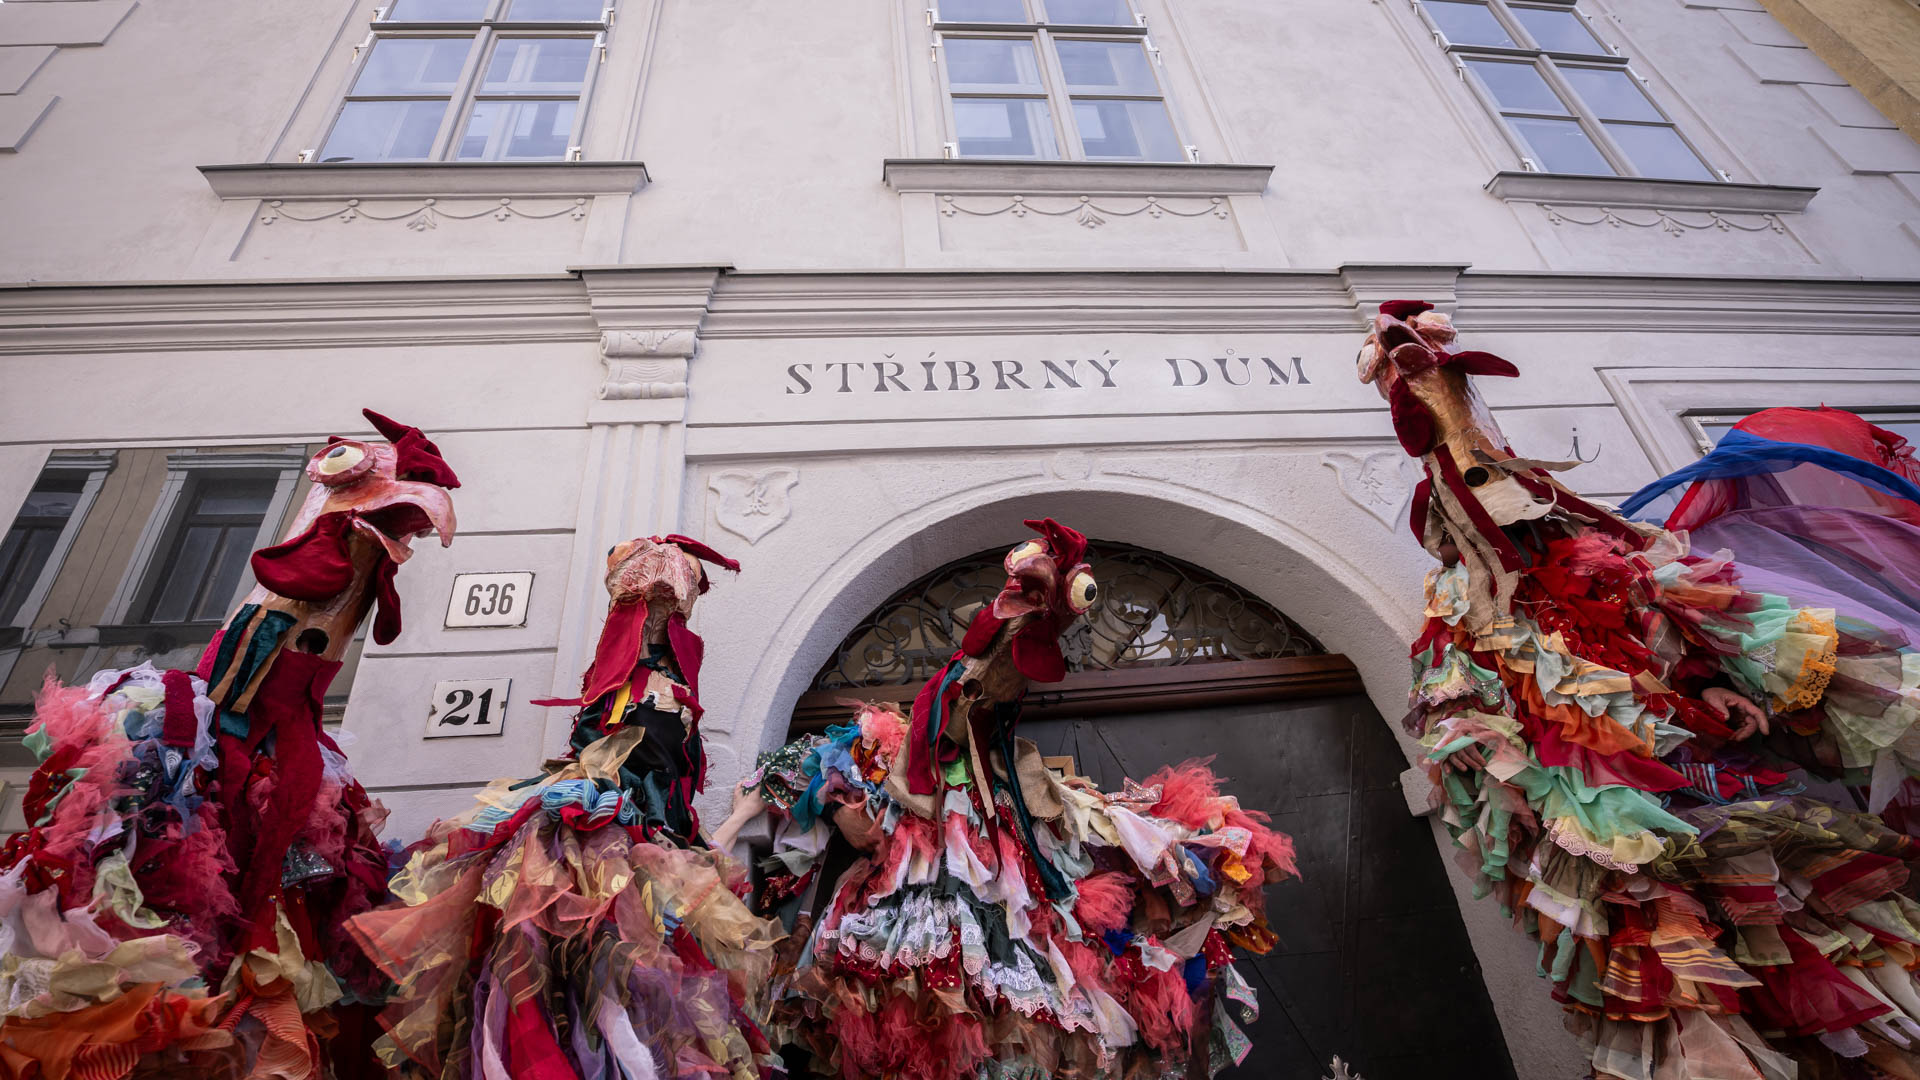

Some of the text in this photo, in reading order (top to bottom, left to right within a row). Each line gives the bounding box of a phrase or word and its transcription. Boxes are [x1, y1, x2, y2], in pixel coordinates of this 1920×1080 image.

[786, 348, 1312, 394] STŘÍBRNÝ DŮM
[465, 583, 516, 616] 636
[439, 688, 493, 727] 21
